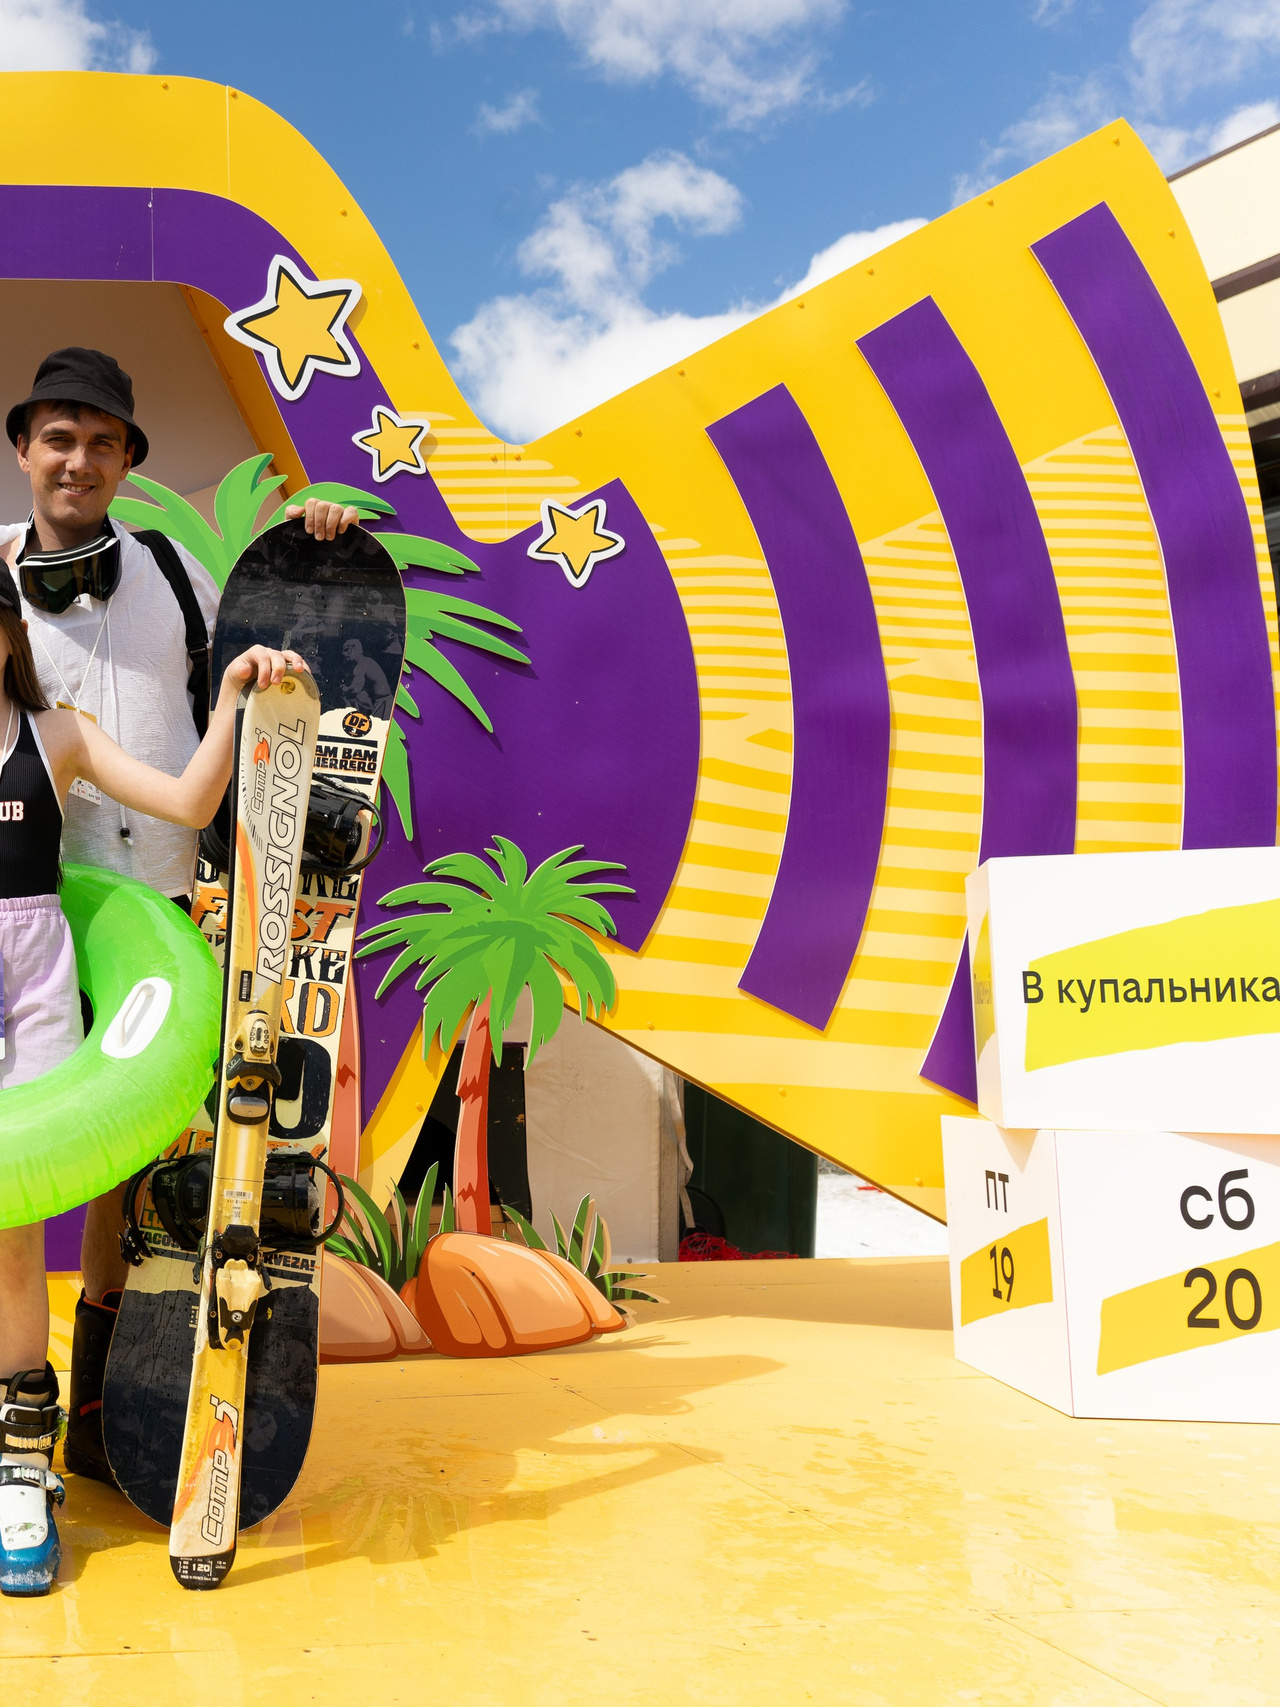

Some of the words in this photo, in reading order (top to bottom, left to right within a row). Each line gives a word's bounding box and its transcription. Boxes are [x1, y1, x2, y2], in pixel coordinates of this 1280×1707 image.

[348, 714, 368, 729] DF
[314, 744, 339, 759] AM
[341, 747, 378, 763] BAM
[255, 718, 306, 985] ROSSIGNOL
[1021, 970, 1044, 1004] В
[1057, 976, 1280, 1013] купальника
[989, 1244, 1015, 1303] 19
[1183, 1265, 1264, 1331] 20
[192, 1563, 210, 1573] 120
